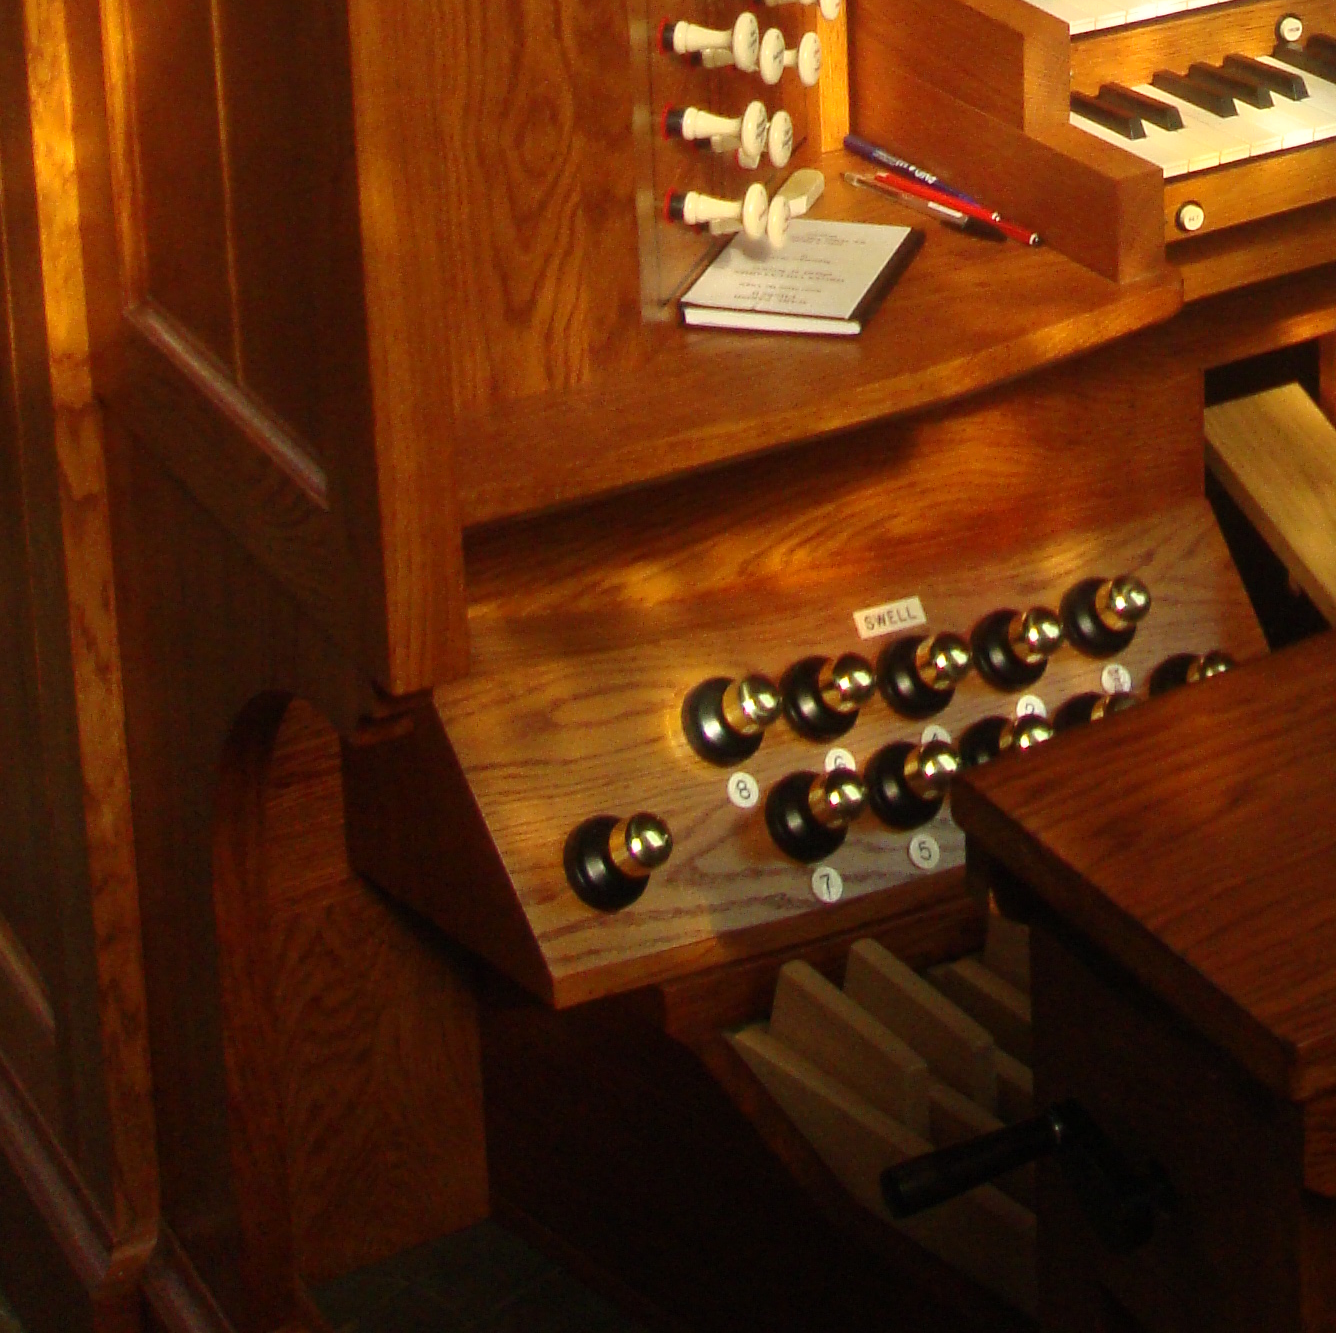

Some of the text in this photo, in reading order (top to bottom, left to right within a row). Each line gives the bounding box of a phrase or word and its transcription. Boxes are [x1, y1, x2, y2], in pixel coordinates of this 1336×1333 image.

[863, 605, 918, 631] SWELL
[735, 779, 752, 801] 8
[918, 840, 933, 862] 5
[819, 873, 832, 899] 7
